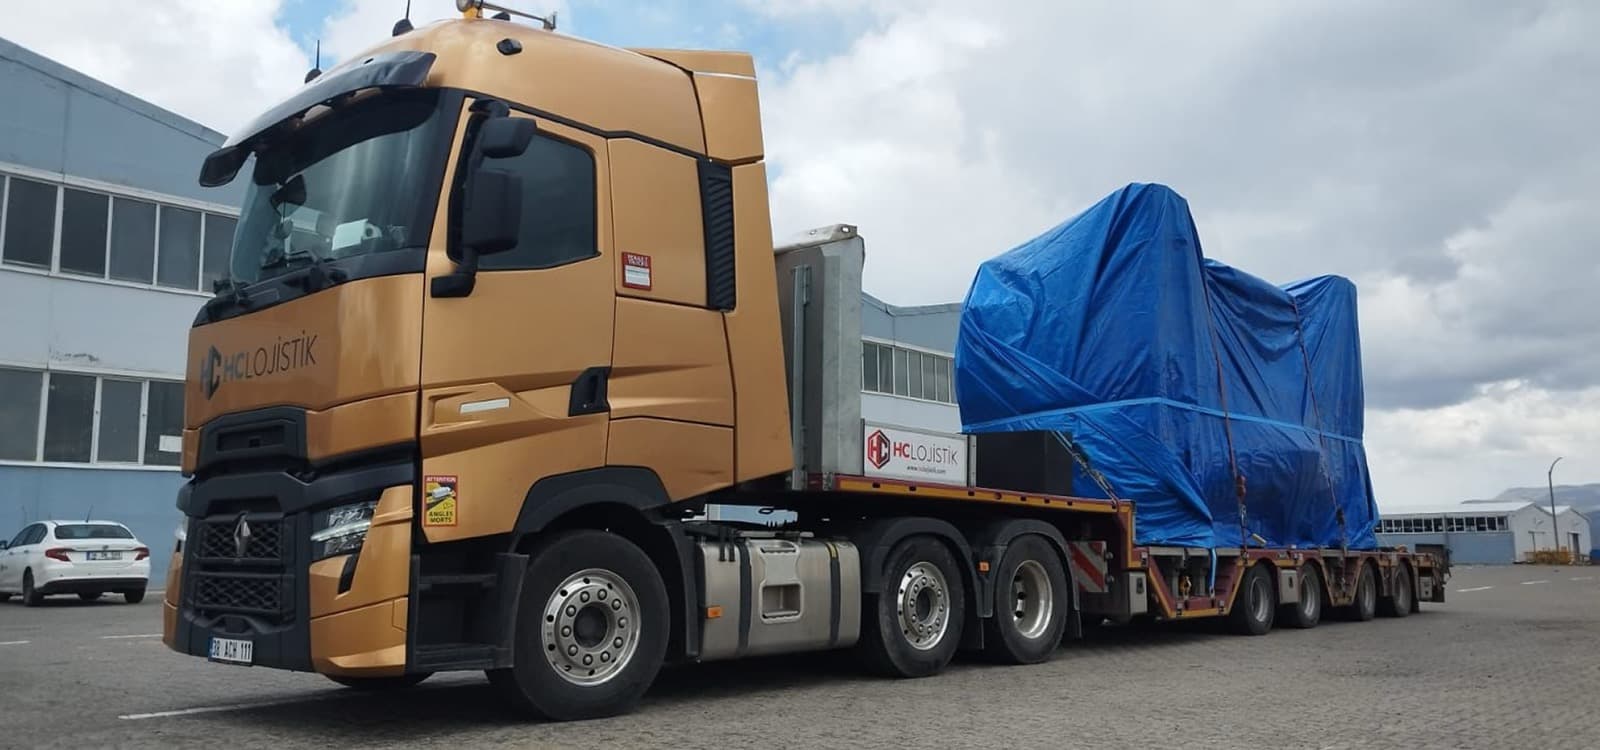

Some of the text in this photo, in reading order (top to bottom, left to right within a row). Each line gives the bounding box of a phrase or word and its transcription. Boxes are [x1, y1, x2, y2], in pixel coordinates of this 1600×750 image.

[223, 330, 318, 383] HCLOJİSTİK
[893, 441, 959, 465] HCLOJİSTİK
[241, 643, 251, 659] 111
